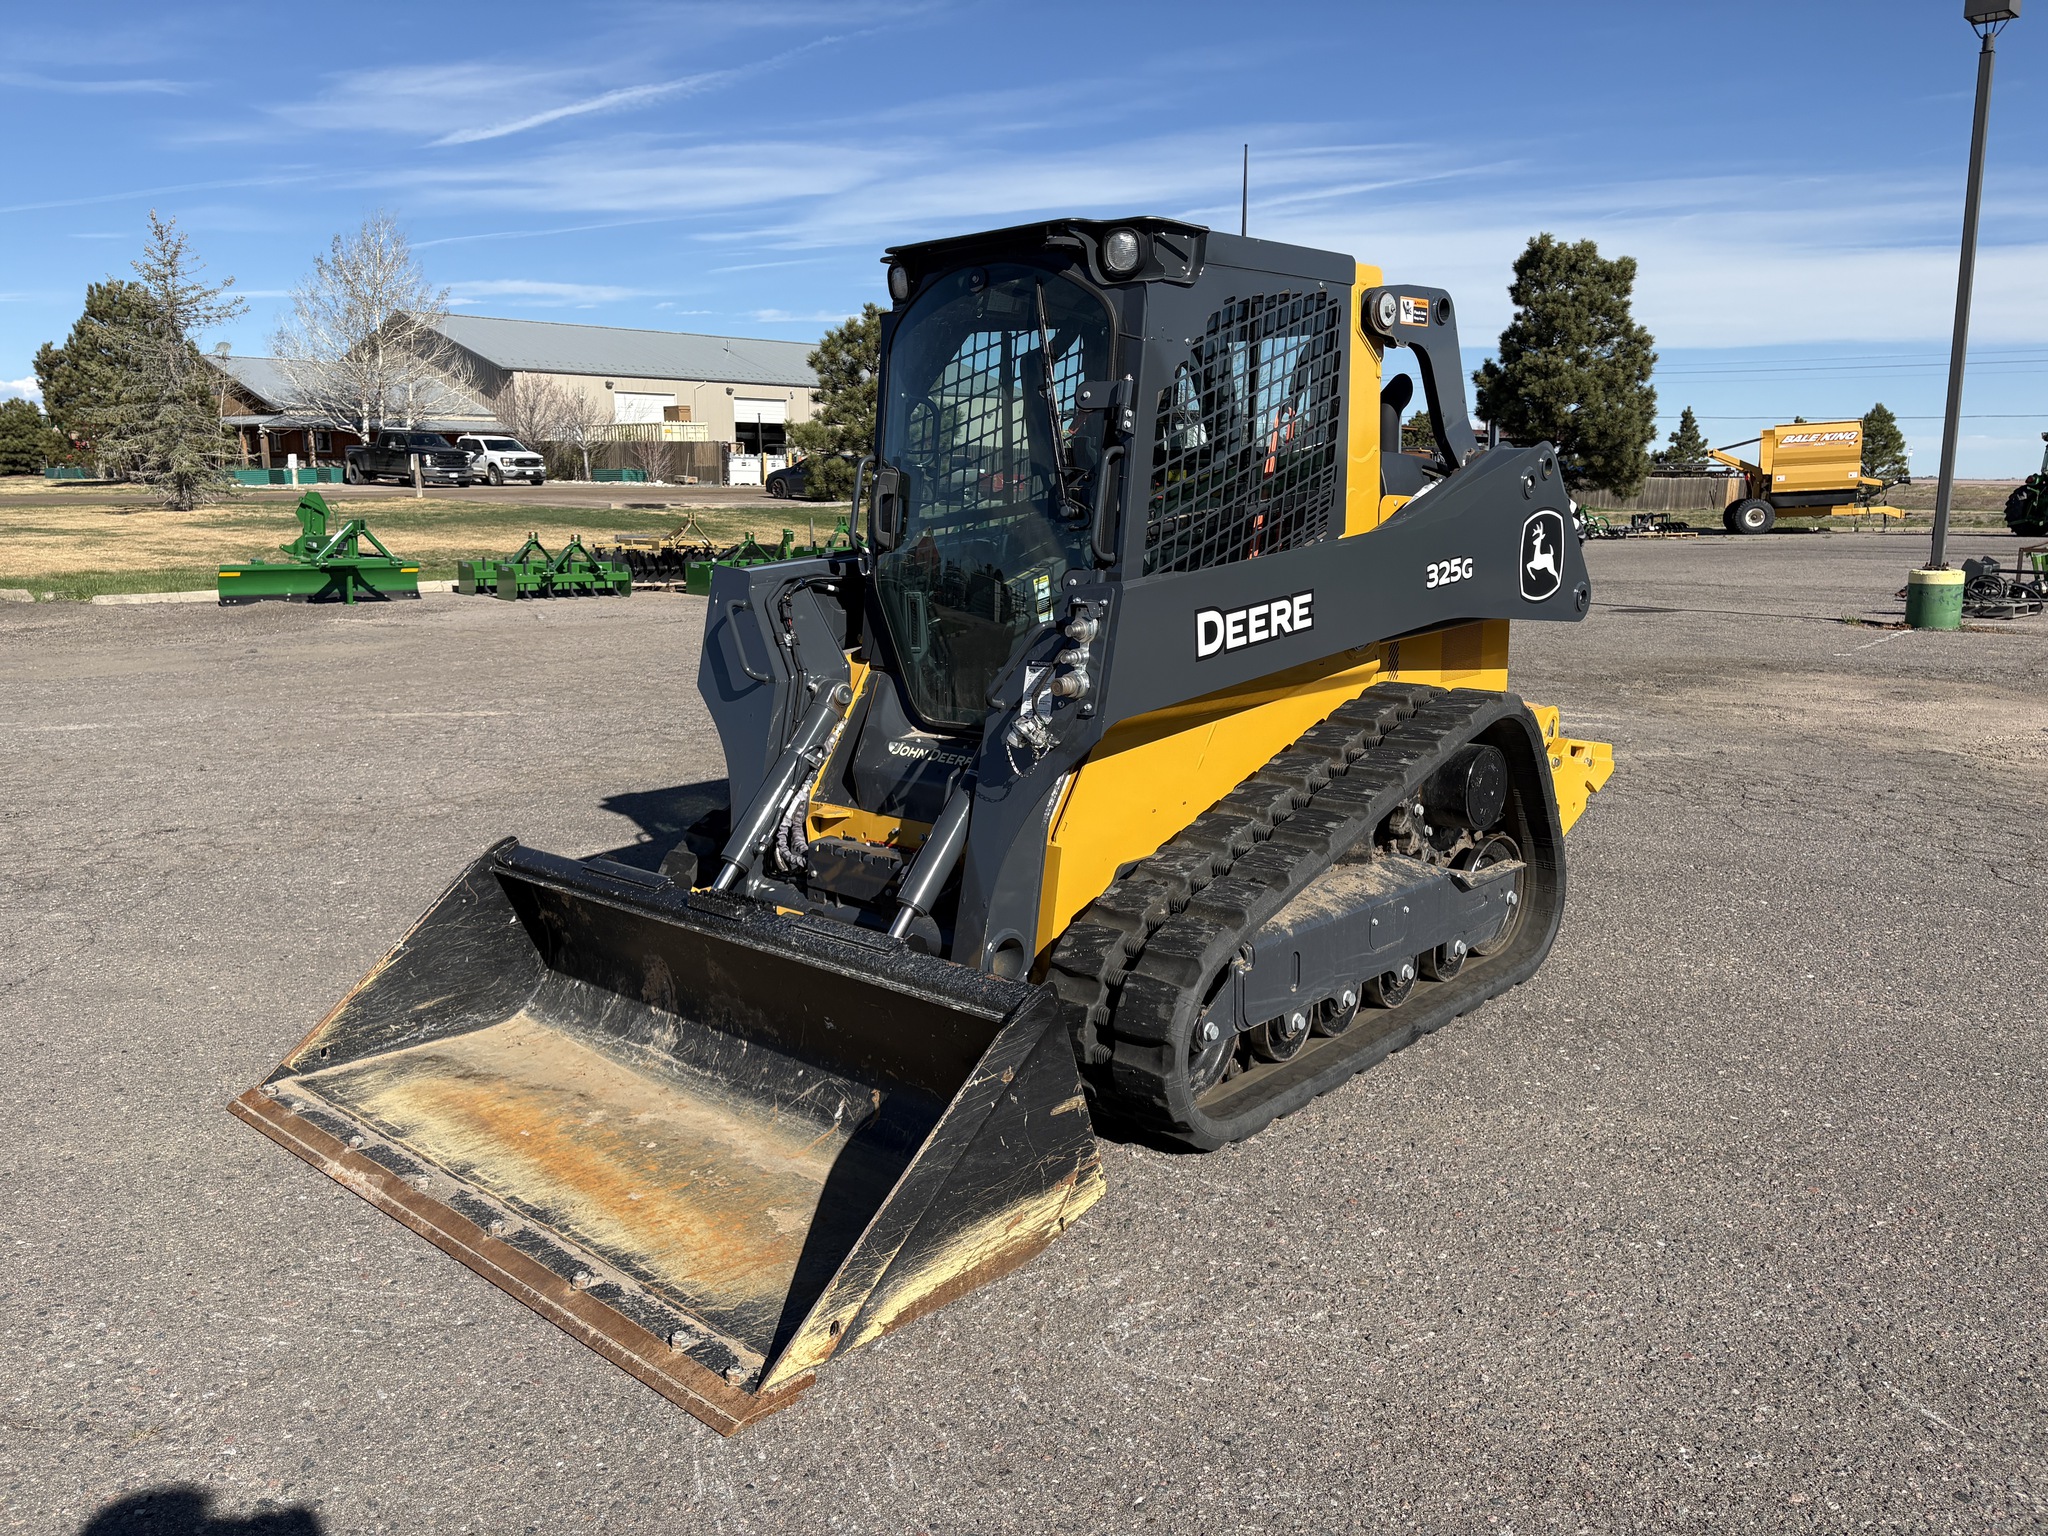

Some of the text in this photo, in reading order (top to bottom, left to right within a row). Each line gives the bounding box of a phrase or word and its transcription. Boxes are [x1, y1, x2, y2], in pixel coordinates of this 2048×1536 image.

[1781, 431, 1858, 443] BALE KING
[1426, 557, 1473, 589] 325G
[1197, 593, 1313, 658] DEERE
[892, 743, 930, 759] JOHN
